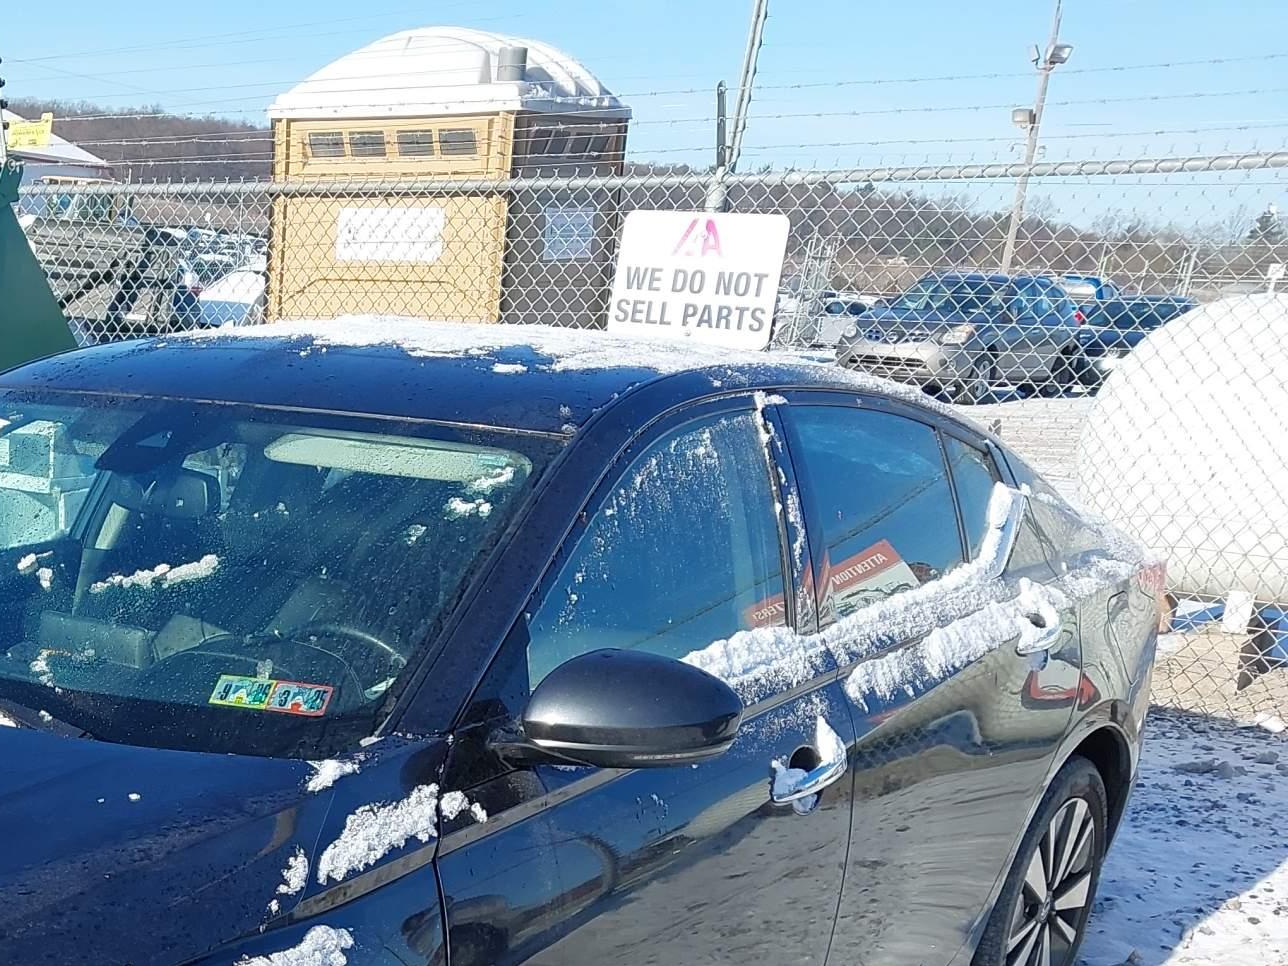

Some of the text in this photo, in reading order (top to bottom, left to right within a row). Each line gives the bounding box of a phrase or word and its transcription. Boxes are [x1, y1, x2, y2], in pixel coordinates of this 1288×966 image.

[626, 266, 769, 297] WE DO NOT
[614, 298, 766, 332] SELL PARTS
